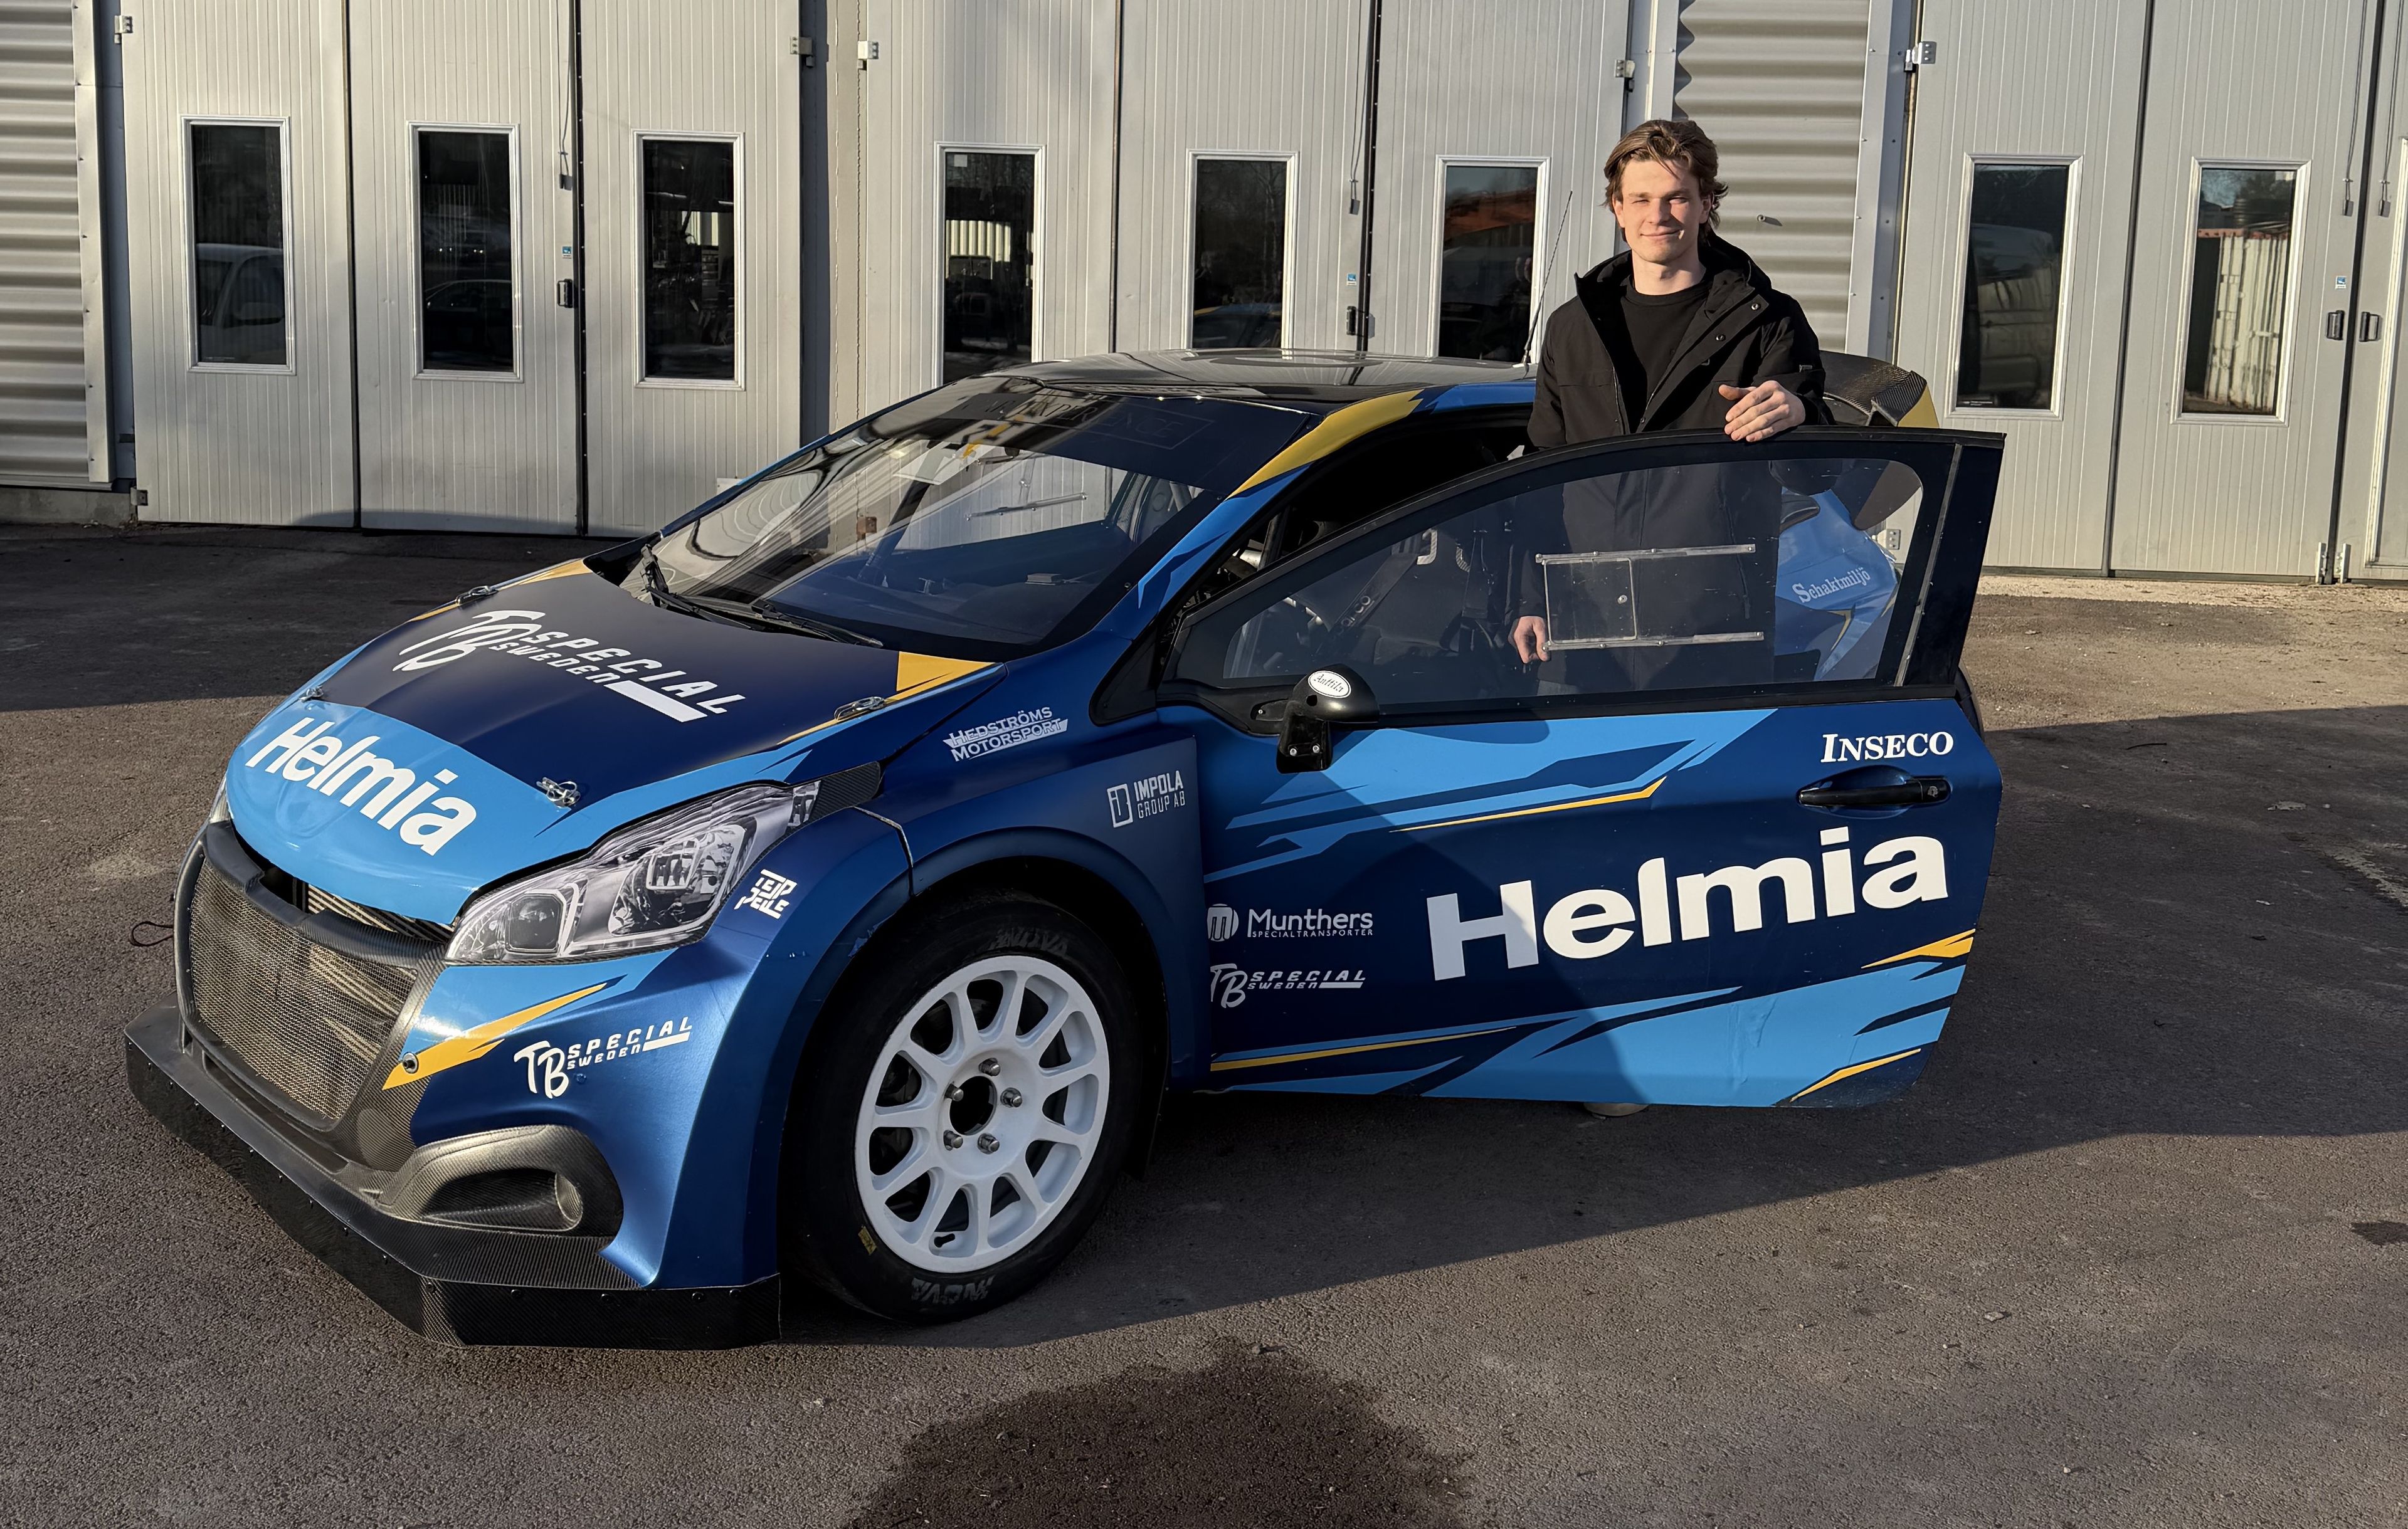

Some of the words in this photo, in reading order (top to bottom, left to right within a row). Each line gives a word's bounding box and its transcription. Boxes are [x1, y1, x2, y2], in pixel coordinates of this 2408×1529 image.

[1792, 567, 1871, 603] Schaktmiljö
[393, 610, 546, 671] TB
[520, 631, 746, 714] SPECIAL
[489, 642, 621, 684] SWEDEN
[949, 707, 1053, 747] HEDSTRÖMS
[951, 718, 1062, 762] MOTORSPORT
[1820, 731, 1954, 764] INSECO
[245, 717, 477, 856] Helmia
[1133, 770, 1184, 802] IMPOLA
[1137, 795, 1170, 819] GROUP
[1174, 791, 1185, 807] AB
[1247, 908, 1373, 938] Munthers
[1427, 826, 1948, 982] Helmia
[1252, 928, 1373, 938] SPECIALTRANSPORTER
[1210, 963, 1248, 1008] TB
[1250, 970, 1366, 981] SPECIAL
[514, 1040, 569, 1099] TB
[567, 1016, 692, 1059] SPECIAL
[567, 1044, 640, 1070] SWEDEN
